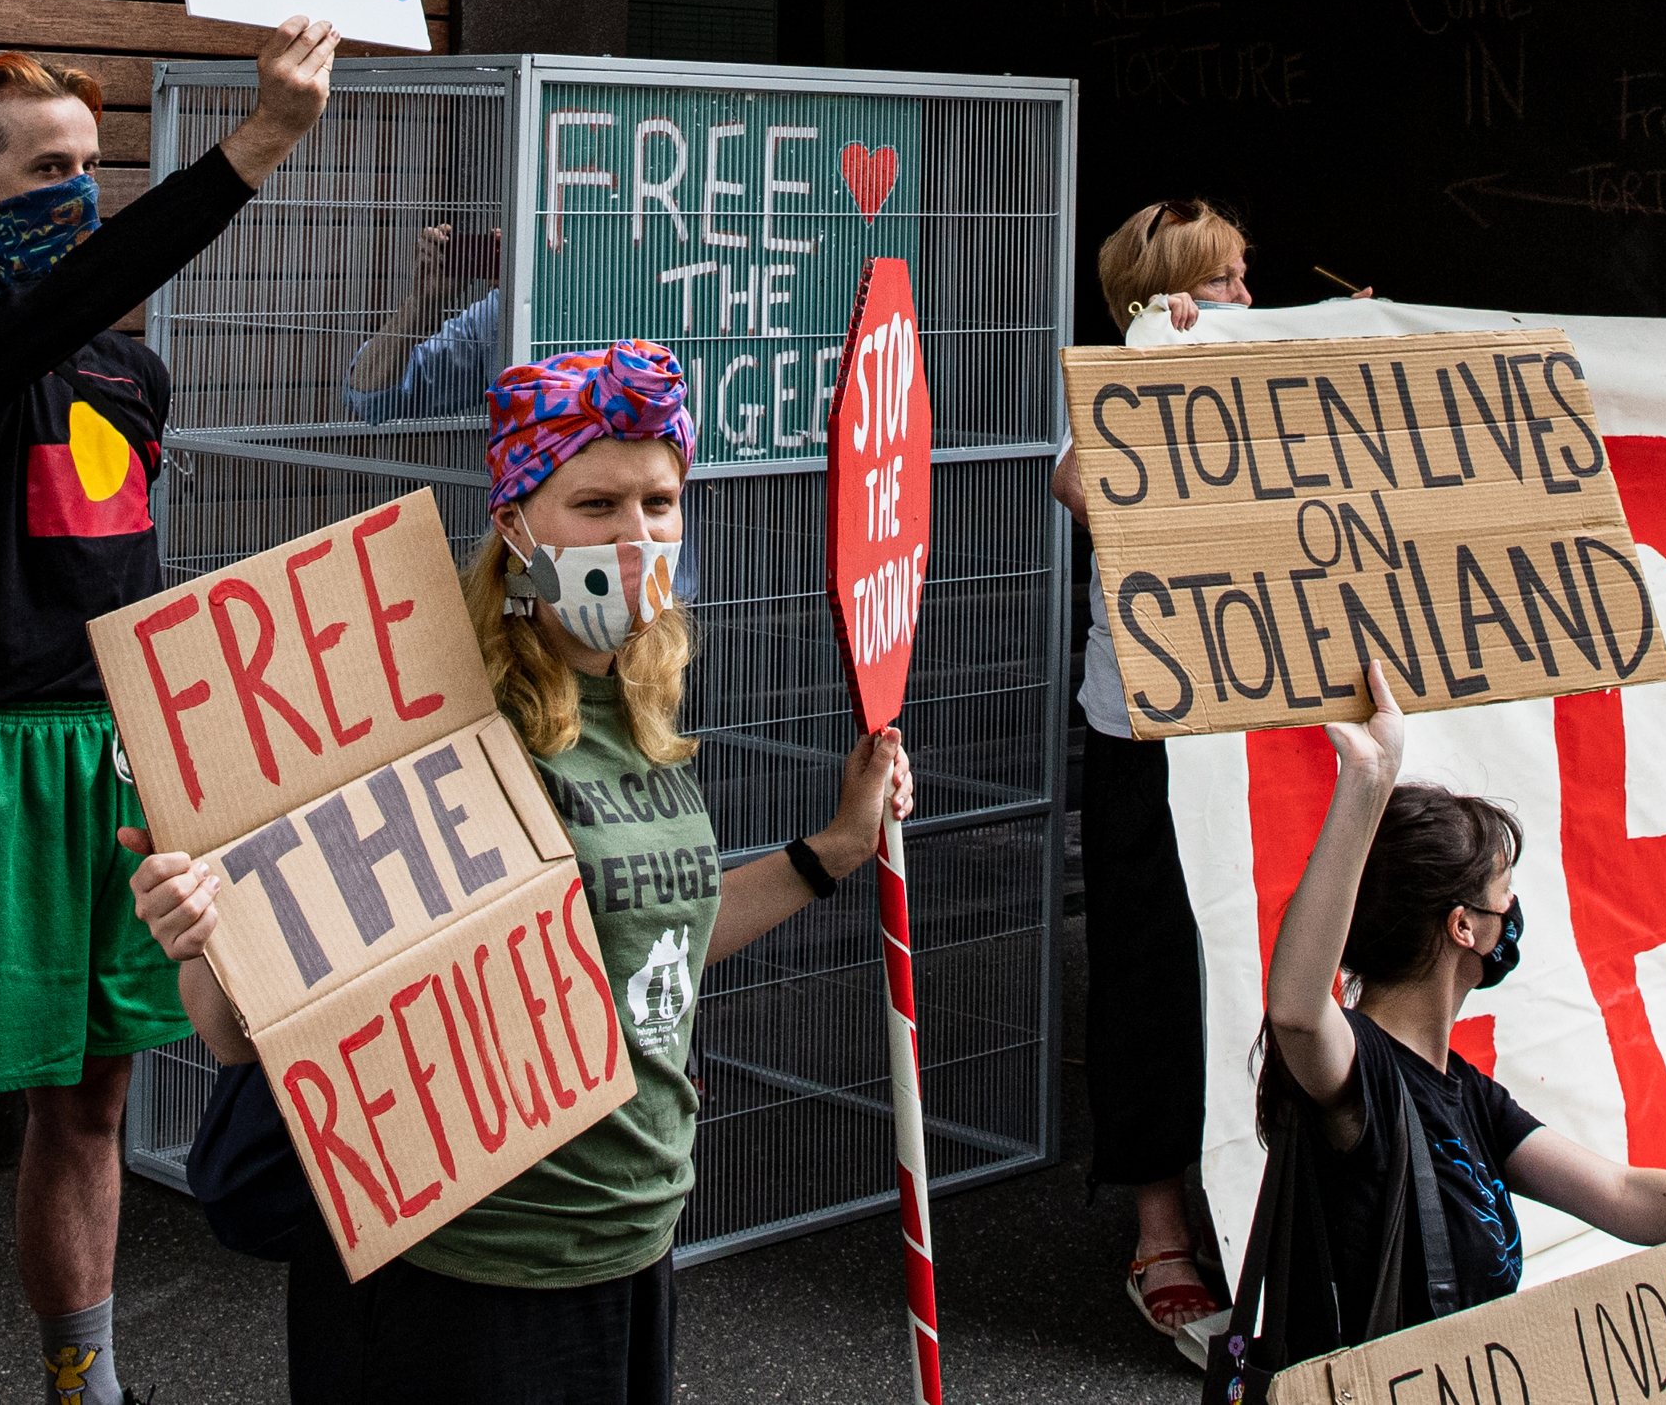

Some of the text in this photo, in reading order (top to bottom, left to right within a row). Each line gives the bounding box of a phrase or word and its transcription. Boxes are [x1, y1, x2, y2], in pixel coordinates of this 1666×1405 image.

[1093, 32, 1312, 108] TORTURE
[1463, 30, 1526, 128] IN
[544, 107, 820, 255] FREE
[657, 259, 798, 337] THE
[854, 311, 916, 458] STOP
[1093, 351, 1605, 506] STOLEN LIVES
[865, 454, 904, 543] THE
[1297, 490, 1402, 571] ON
[134, 503, 446, 812] FREE
[853, 543, 924, 667] TORTURE
[1117, 536, 1654, 723] STOLEN LAND
[544, 763, 706, 828] WELCOM
[221, 744, 508, 990] THE
[577, 844, 721, 917] REFUGE
[283, 877, 620, 1249] REFUGEES
